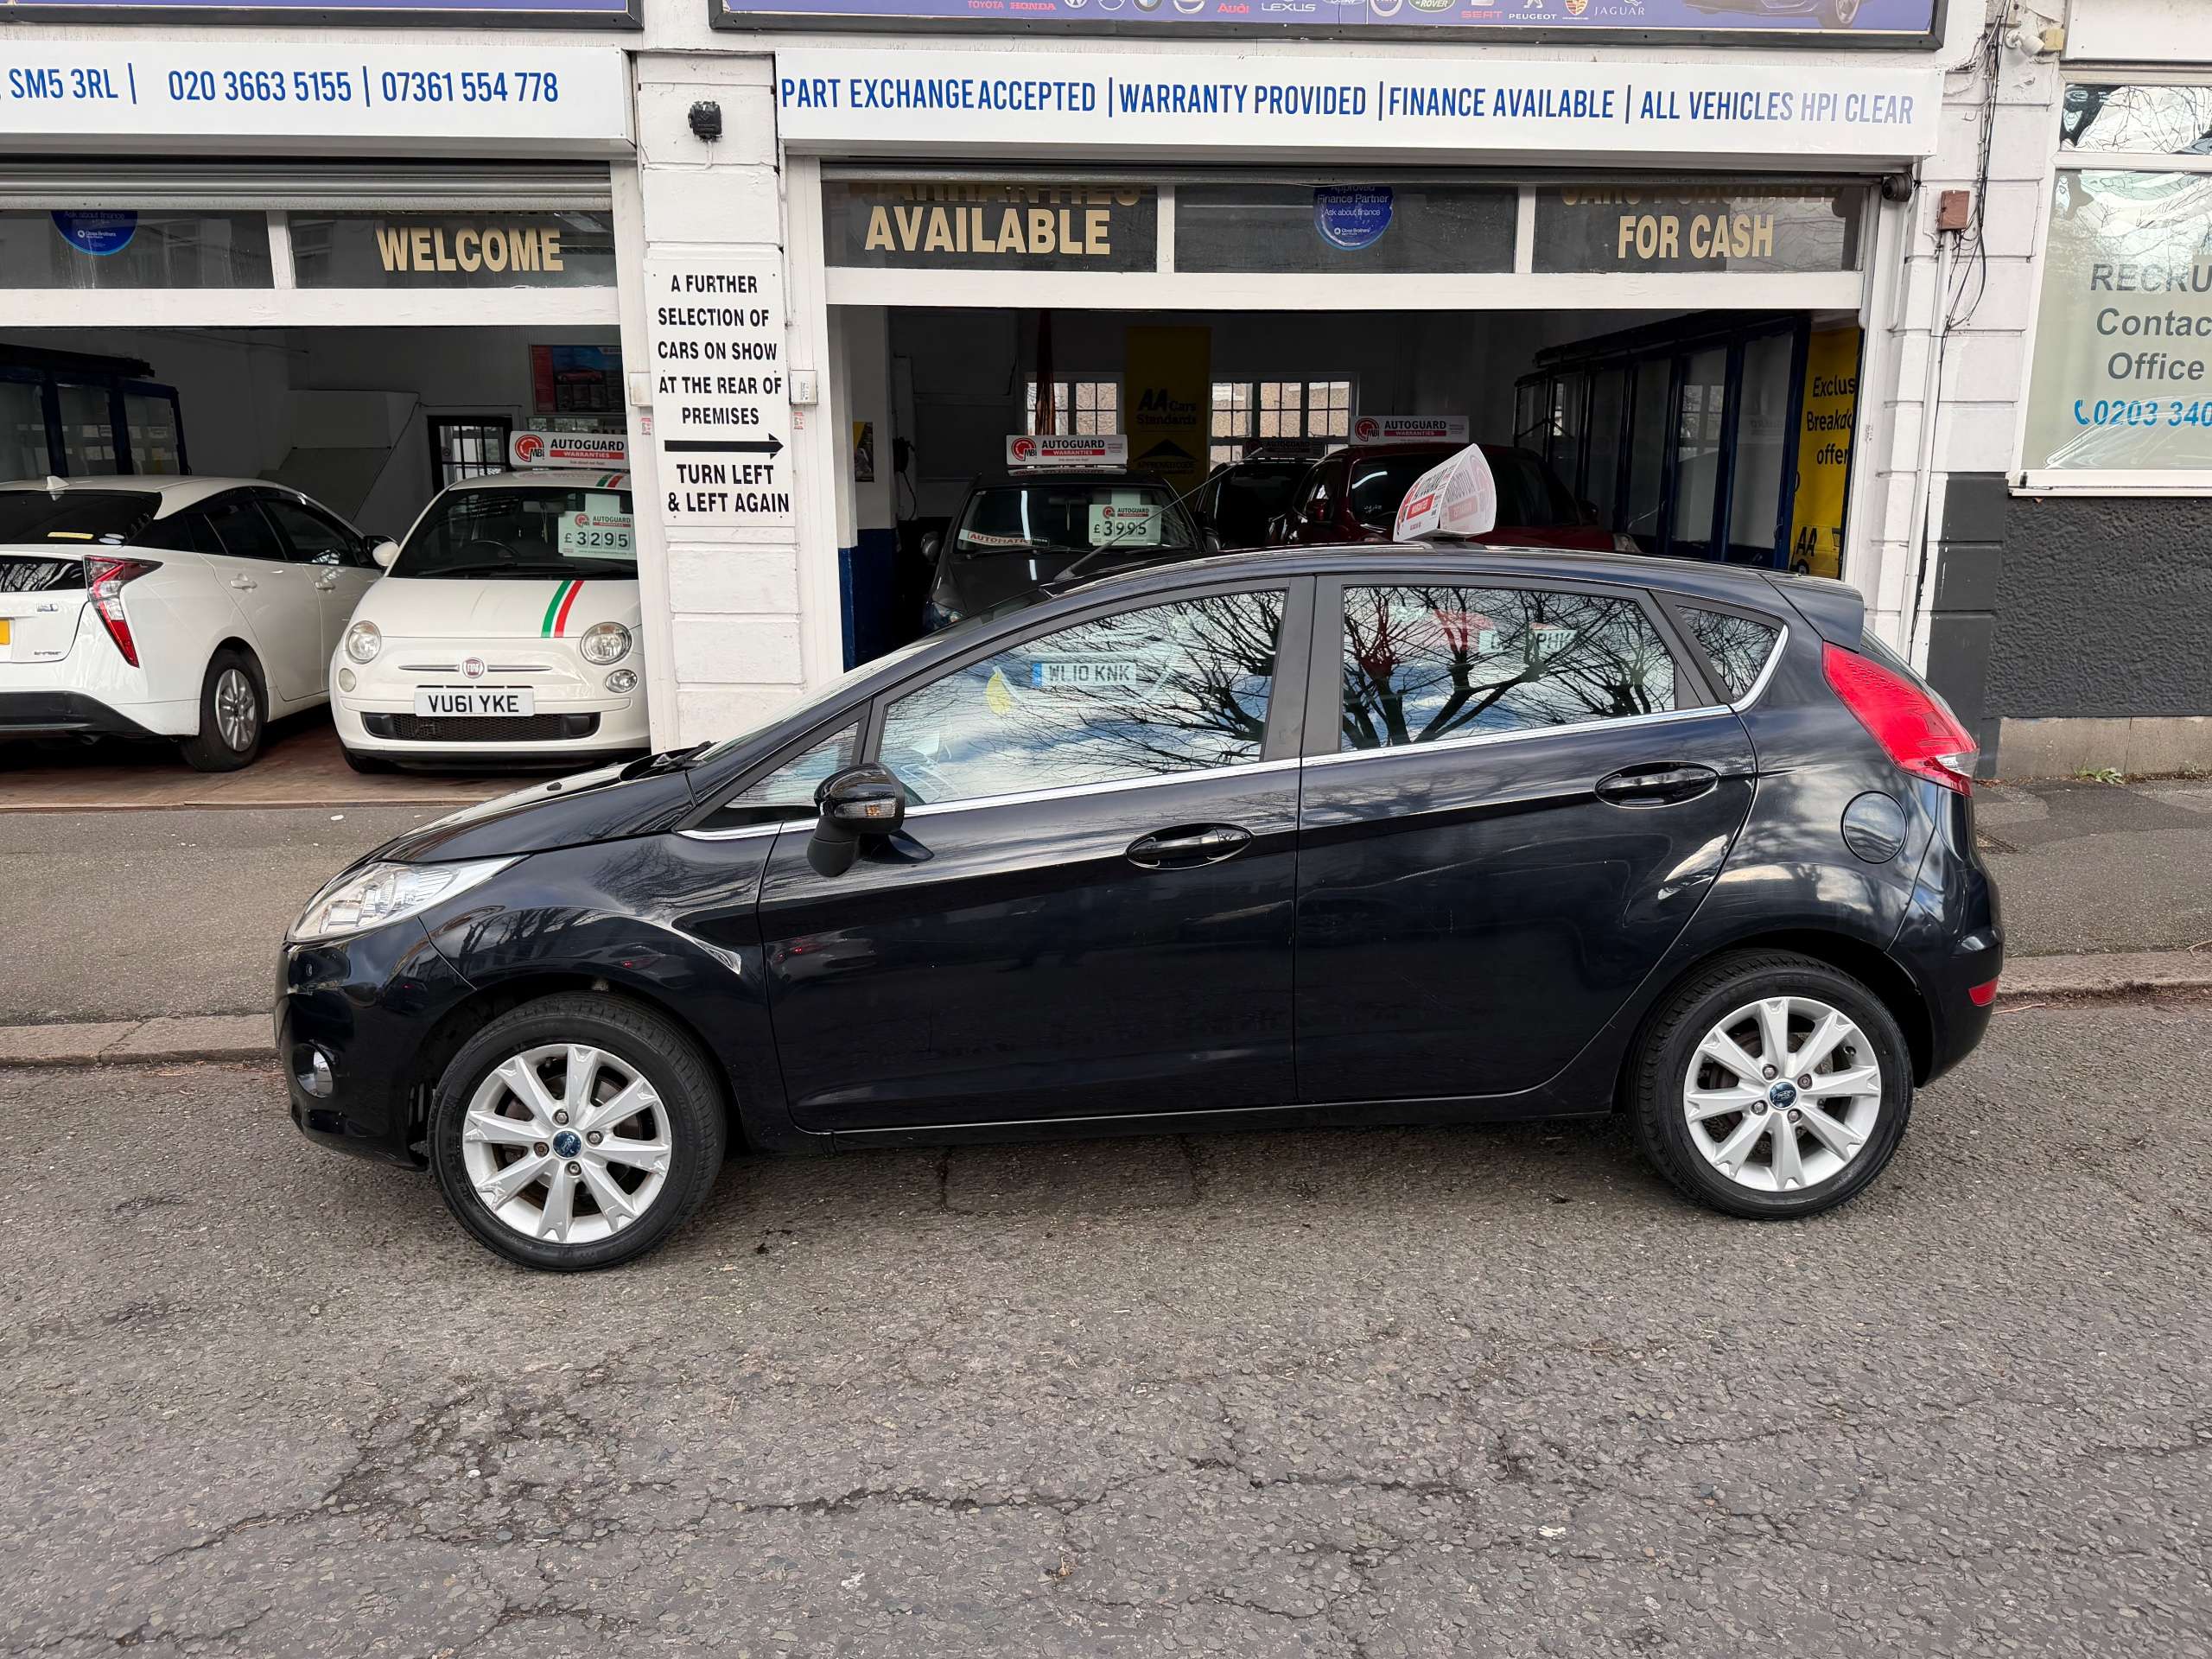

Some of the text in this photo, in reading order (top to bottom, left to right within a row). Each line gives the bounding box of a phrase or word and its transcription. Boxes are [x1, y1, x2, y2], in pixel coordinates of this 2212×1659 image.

[967, 1, 1057, 10] TOYOTA HONDA
[1217, 3, 1315, 13] Audi LEXUS
[1460, 10, 1503, 19] SEAT
[1594, 6, 1645, 16] JAGUAR
[8, 67, 558, 104] SM5 3RL 020 3663 5155 07361 554 778
[781, 78, 842, 110] PART
[1120, 83, 1248, 115] WARRANTY
[1254, 85, 1366, 116] PROVIDED
[1389, 87, 1485, 118] FINANCE
[1492, 89, 1614, 118] AVAILABLE
[1639, 91, 1681, 119] ALL
[1688, 91, 1794, 122] VEHICLES
[1800, 93, 1837, 122] HPI
[1844, 94, 1914, 124] CLEAR
[1318, 194, 1389, 204] Finance Partner
[1338, 208, 1357, 217] about
[865, 206, 1111, 256] AVAILABLE
[1618, 214, 1774, 259] FOR CASH
[377, 226, 564, 272] WELCOME
[671, 275, 758, 294] A FURTHER
[658, 308, 769, 327] SELECTION OF
[658, 341, 777, 360] CARS ON SHOW
[2107, 353, 2205, 380] Office
[658, 377, 677, 394] AT
[682, 377, 712, 394] THE
[717, 377, 758, 394] REAR
[762, 377, 782, 395] OF
[682, 407, 760, 425] PREMISES
[2093, 400, 2158, 426] 0203
[1384, 420, 1446, 429] AUTOGUARD
[550, 439, 625, 451] AUTOGUARD
[1042, 440, 1105, 449] AUTOGUARD
[677, 464, 774, 485] TURN LEFT
[668, 492, 790, 512] & LEFT AGAIN
[1796, 526, 1817, 556] AA
[1095, 665, 1130, 682] KNK
[429, 695, 519, 713] VU61 YKE
